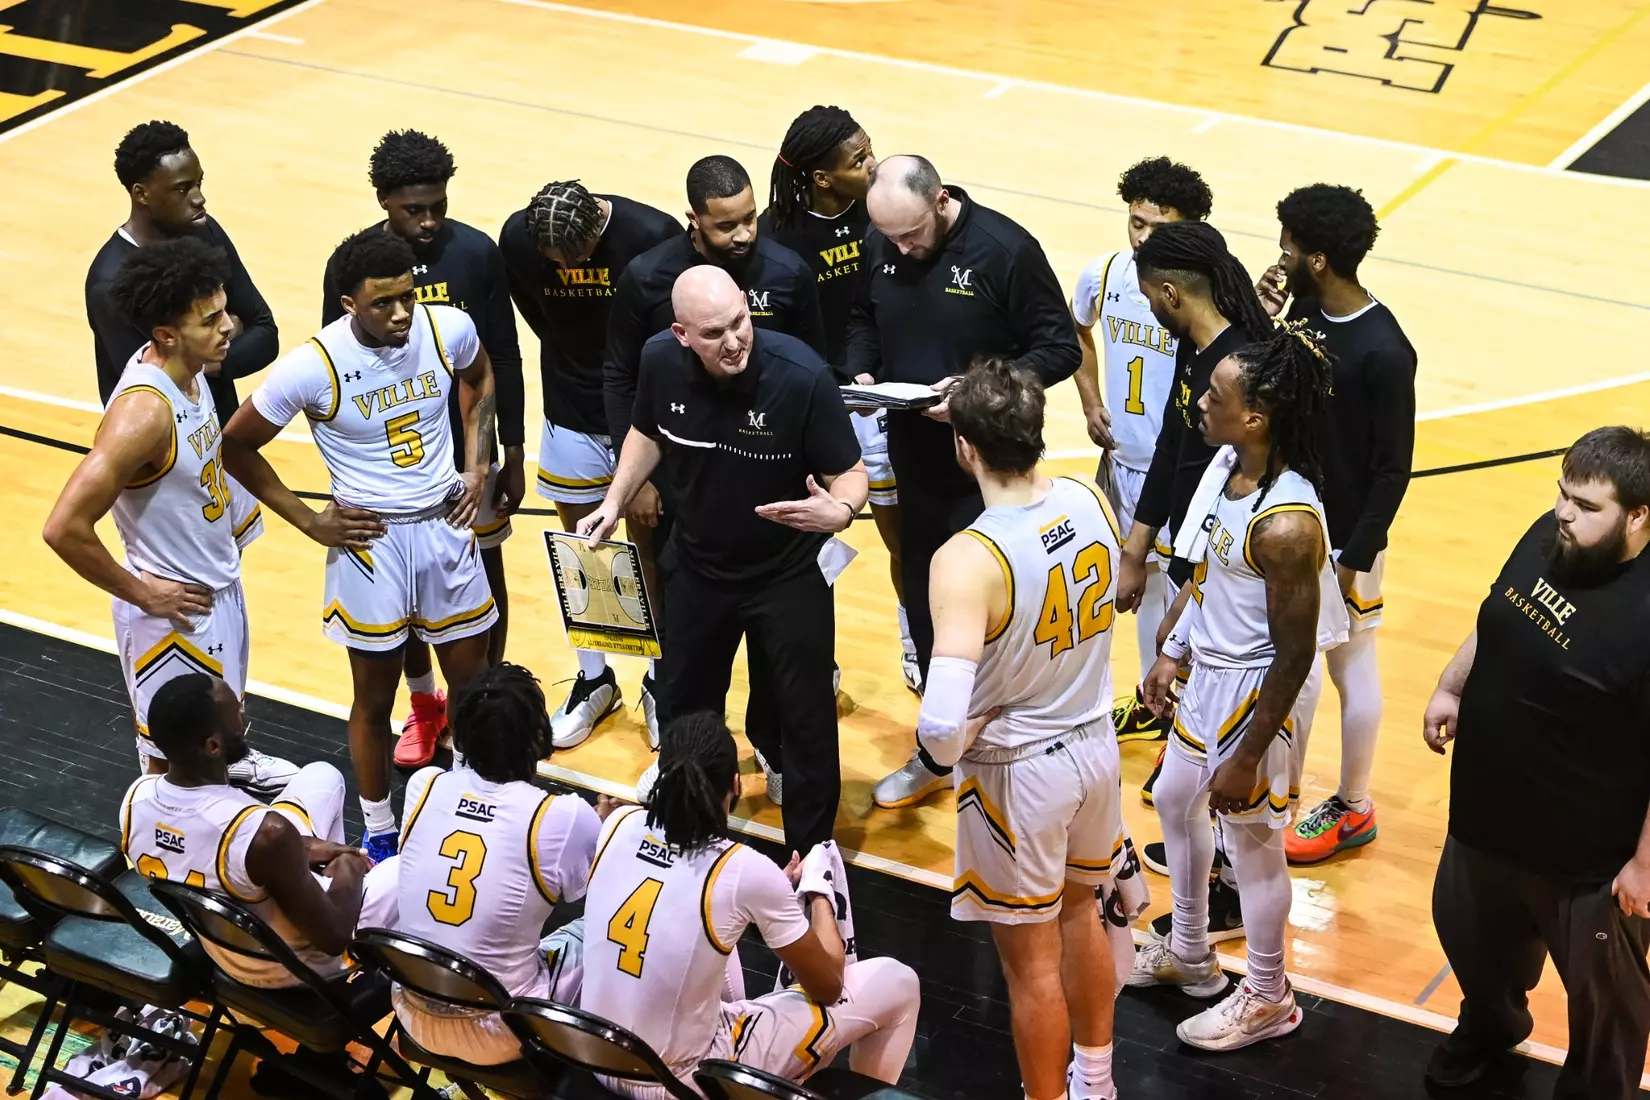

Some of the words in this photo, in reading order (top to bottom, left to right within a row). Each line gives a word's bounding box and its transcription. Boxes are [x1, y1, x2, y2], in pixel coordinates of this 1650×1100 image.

[817, 262, 859, 283] ASKET
[820, 239, 863, 267] VILL
[413, 281, 450, 304] LLE
[544, 287, 617, 297] BASKETBA
[556, 267, 611, 287] VILLE
[1107, 315, 1175, 357] VILLE
[352, 370, 441, 420] VILLE
[1125, 355, 1145, 416] 1
[187, 406, 222, 460] VILL
[385, 410, 425, 468] 5
[1041, 519, 1075, 548] PSAC
[1033, 540, 1113, 660] 42
[1504, 586, 1571, 650] BASKETBALL
[1530, 576, 1577, 626] VILLE
[457, 798, 497, 818] PSAC
[155, 828, 185, 849] PSAC
[638, 839, 678, 864] PSAC
[426, 829, 488, 927] 3
[607, 876, 665, 980] 4
